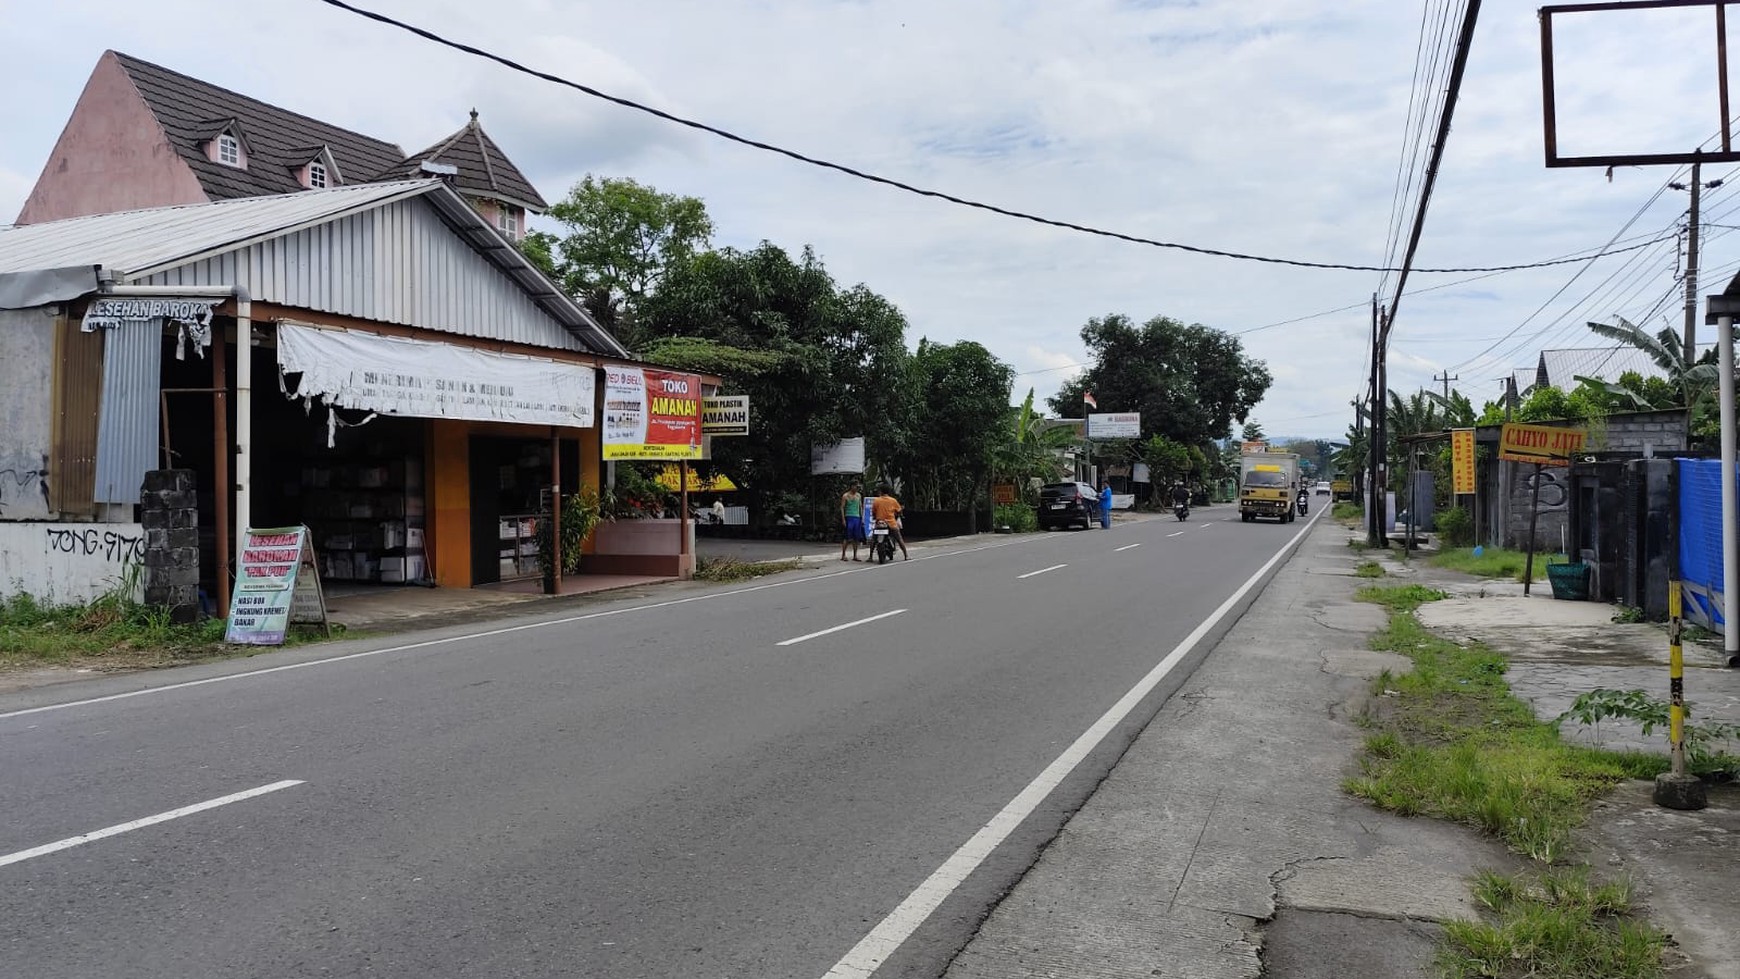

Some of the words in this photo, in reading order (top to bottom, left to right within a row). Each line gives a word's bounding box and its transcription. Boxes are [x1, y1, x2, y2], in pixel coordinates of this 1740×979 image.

[662, 380, 688, 394] TOKO
[651, 397, 697, 416] AMANAH
[702, 411, 746, 423] AMANAH
[1505, 428, 1548, 448] CAHYO
[1551, 432, 1583, 450] JATI
